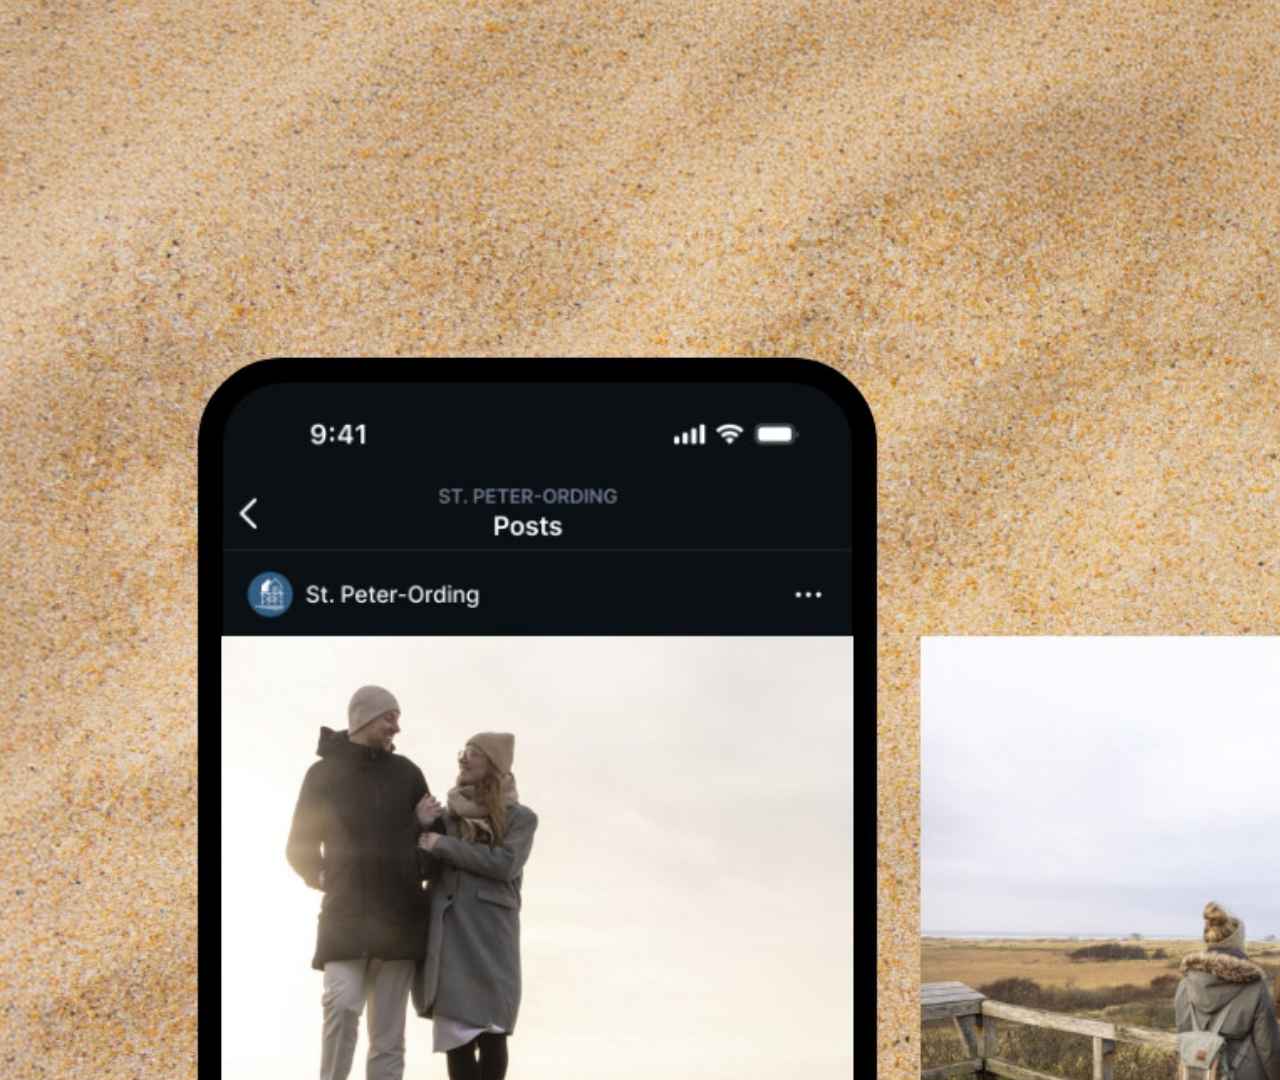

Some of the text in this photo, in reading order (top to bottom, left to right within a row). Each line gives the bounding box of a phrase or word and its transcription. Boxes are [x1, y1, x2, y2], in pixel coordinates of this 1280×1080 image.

[310, 423, 366, 445] 9:41
[439, 487, 618, 505] ST. PETER-ORDING
[494, 515, 563, 537] Posts
[306, 584, 480, 609] St. Peter-Ording
